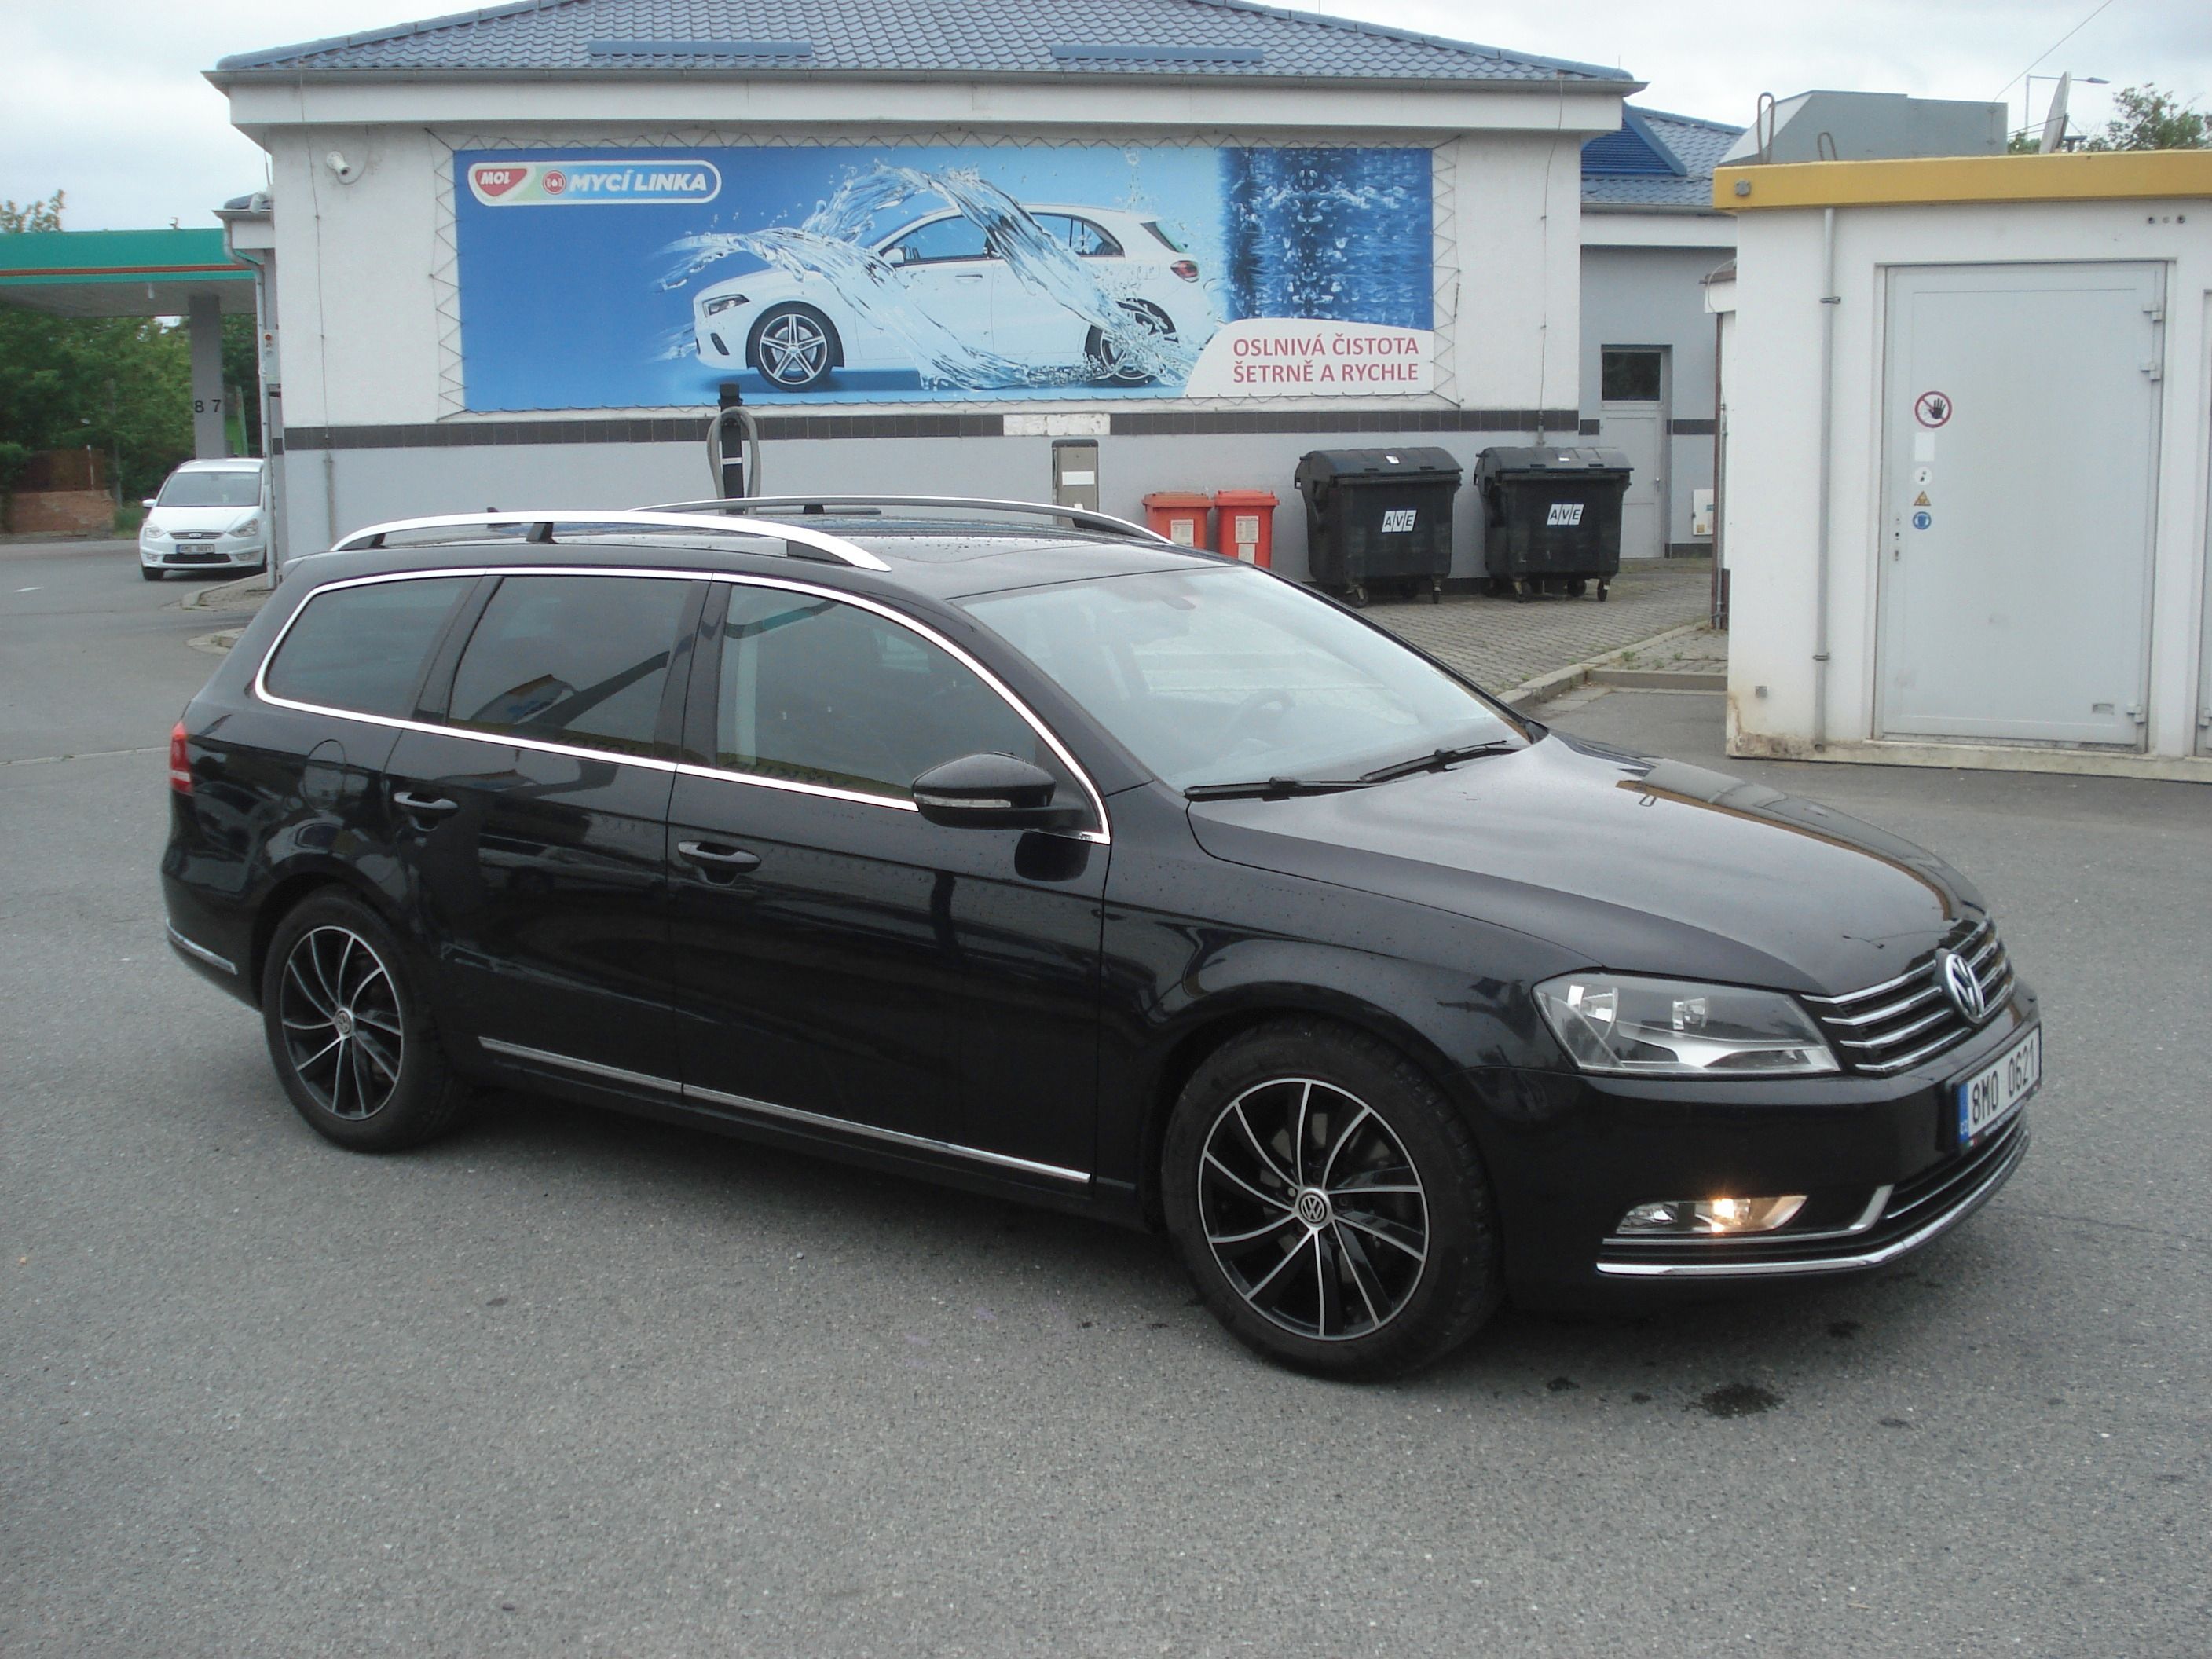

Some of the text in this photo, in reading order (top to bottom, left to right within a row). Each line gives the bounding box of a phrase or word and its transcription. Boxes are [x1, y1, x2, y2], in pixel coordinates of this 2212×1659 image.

[480, 171, 510, 185] MOL
[569, 170, 707, 192] MYCÍ LINKA
[1233, 333, 1419, 357] OSLNIVÁ ČISTOTA
[1233, 360, 1419, 383] ŠETRNĚ A RYCHLE
[194, 399, 222, 413] 8 7
[1383, 514, 1415, 528] AVE
[1548, 507, 1581, 521] AVE
[2008, 1038, 2035, 1097] 0621
